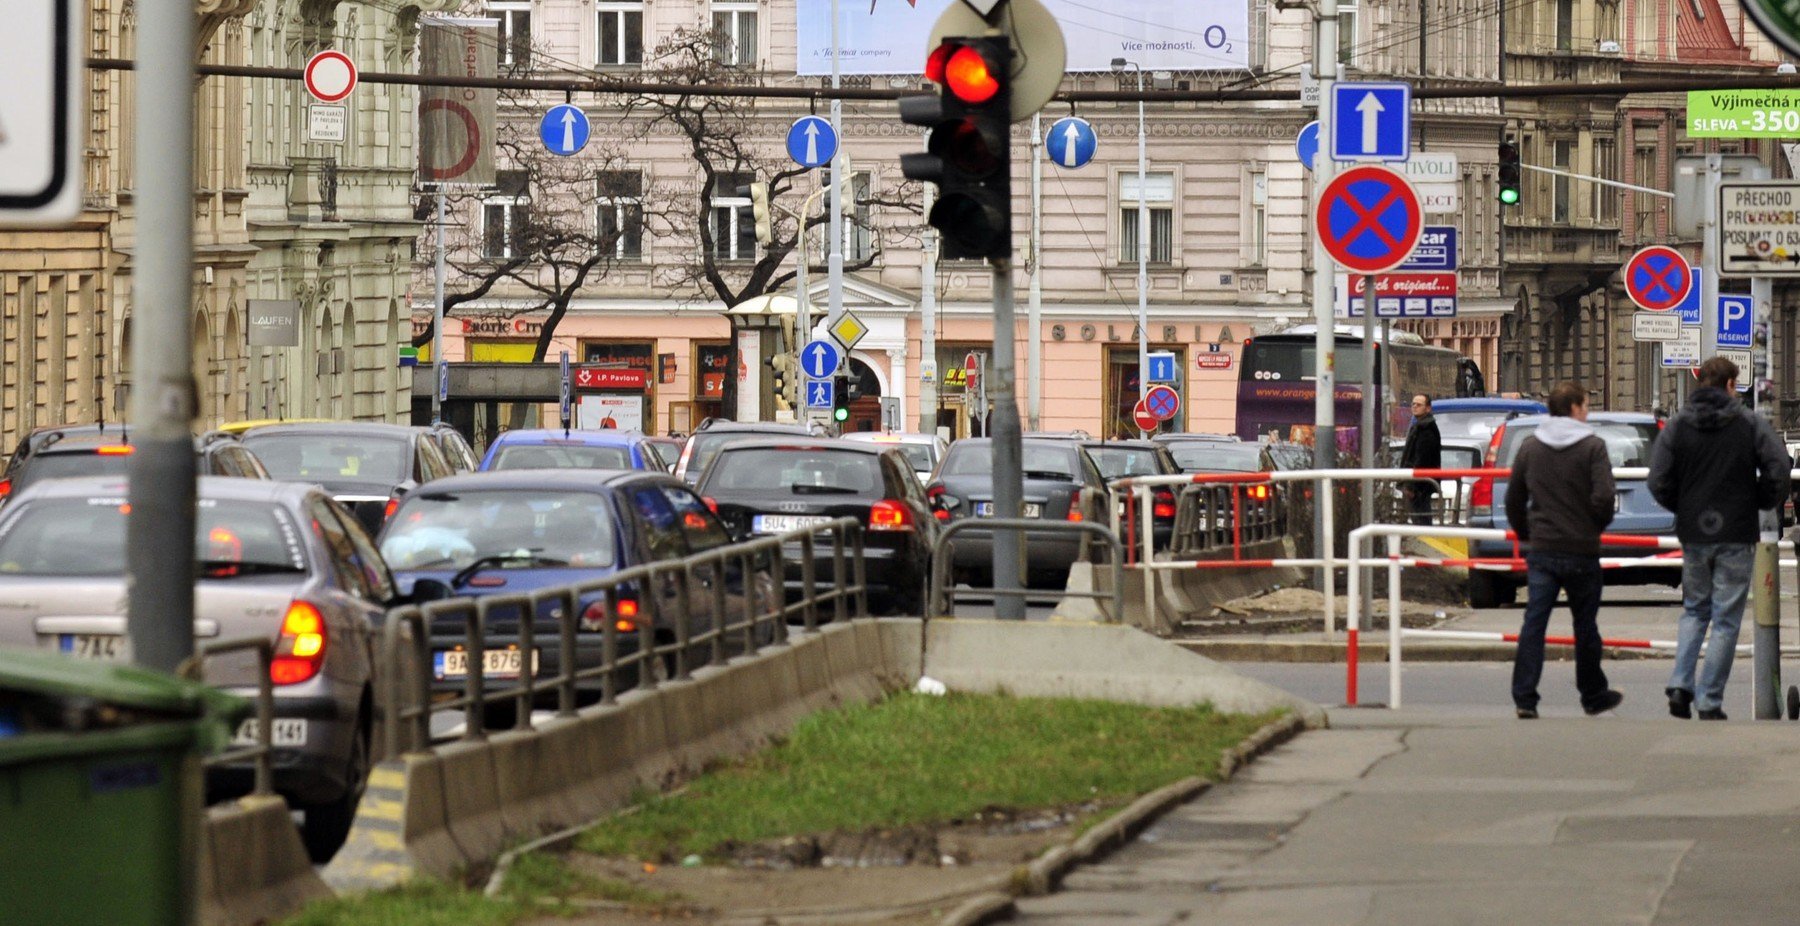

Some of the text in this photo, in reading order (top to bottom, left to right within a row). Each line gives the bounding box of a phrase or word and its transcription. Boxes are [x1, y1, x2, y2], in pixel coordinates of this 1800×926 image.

[1121, 40, 1196, 51] Více možnosti.
[463, 27, 477, 101] Oerbank
[1711, 95, 1790, 111] Výjimečná
[1694, 118, 1739, 131] SLEVA
[1405, 161, 1453, 174] TIVOLI
[1736, 190, 1792, 206] PŘECHOD
[1421, 232, 1448, 245] car
[1355, 276, 1389, 294] Cch
[252, 316, 292, 326] LAUFEN
[1724, 300, 1746, 331] P
[1052, 324, 1234, 342] SOLARIA
[1718, 332, 1749, 343] RÉSERVÉ
[610, 374, 640, 382] Pavlova
[1256, 388, 1363, 399] www.oranges.com
[448, 654, 521, 671] 9A 876
